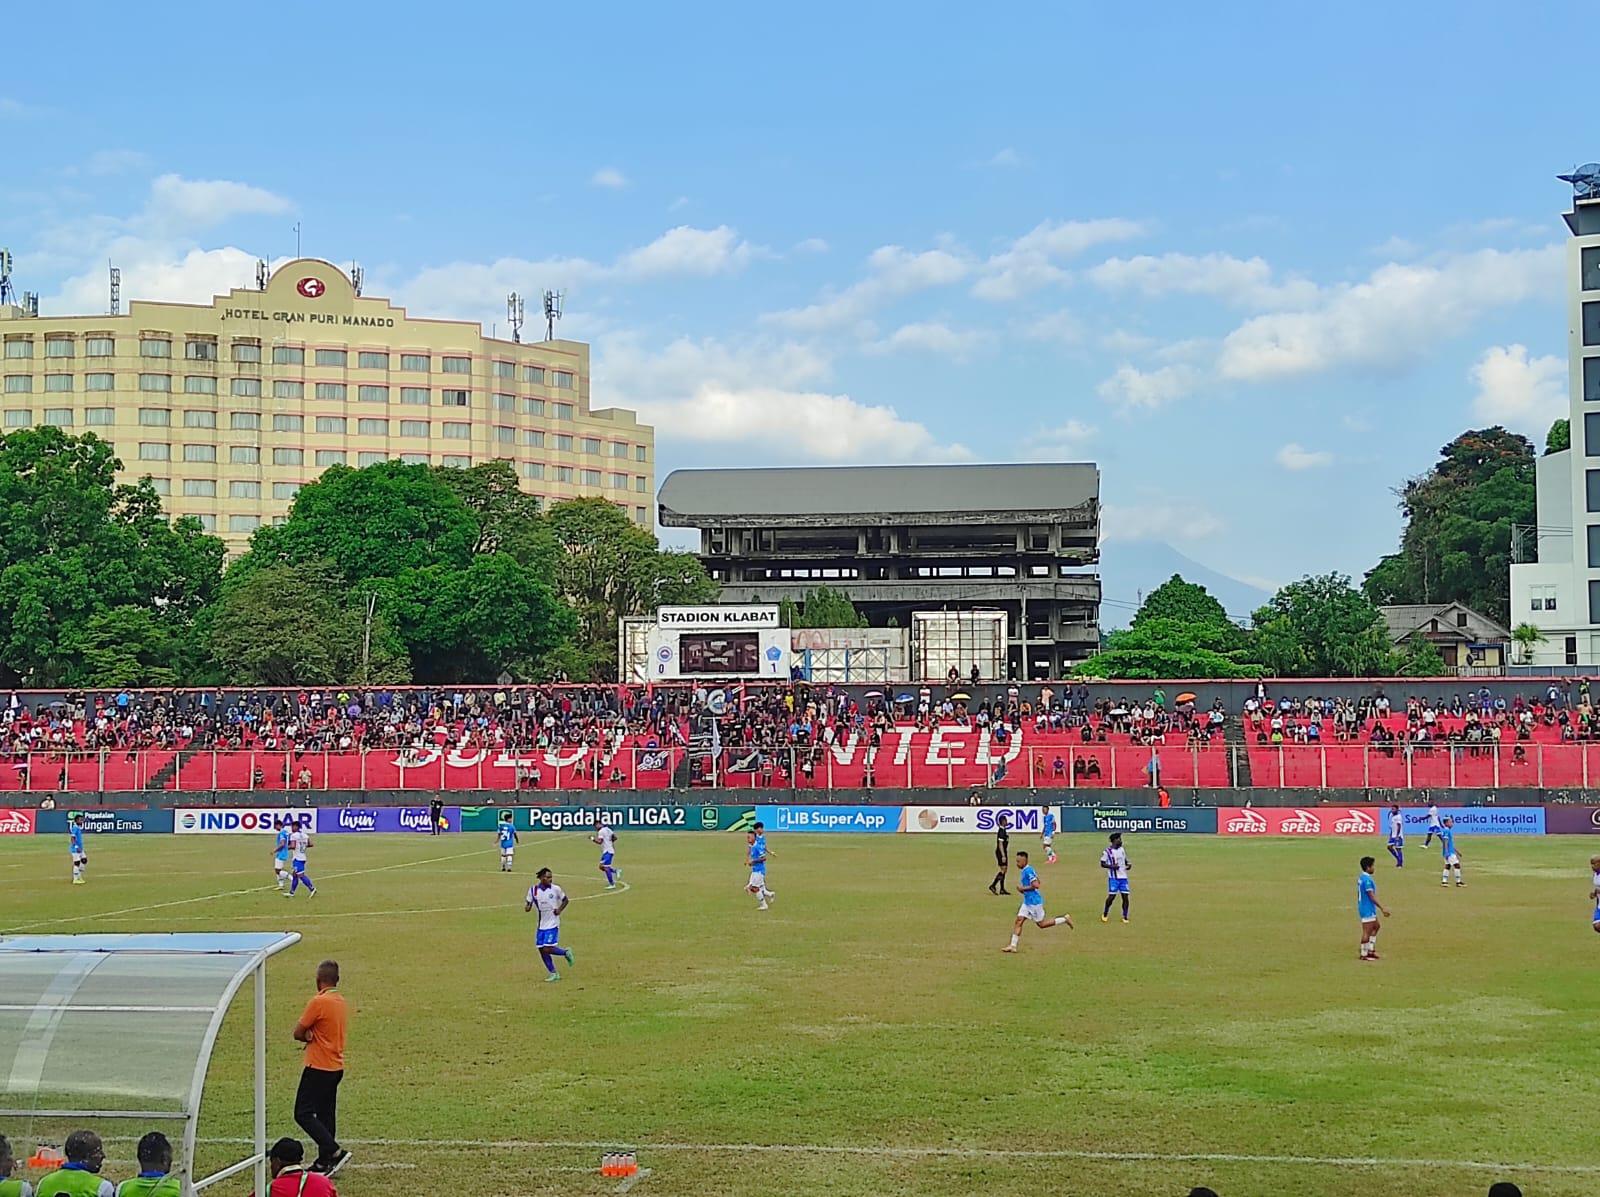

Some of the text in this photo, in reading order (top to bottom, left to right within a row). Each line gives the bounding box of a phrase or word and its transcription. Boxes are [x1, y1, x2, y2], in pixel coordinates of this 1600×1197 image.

[225, 308, 394, 328] HOTEL GRAN PURI MANADO
[661, 611, 776, 622] STADION KLABAT
[67, 819, 142, 832] Tungan Emas
[200, 812, 313, 830] INDOSIAR
[529, 808, 685, 830] Pegadaian LIGA 2
[787, 812, 885, 828] LIB Super App
[940, 815, 965, 824] Emtek
[976, 809, 1038, 830] SCM
[1095, 817, 1186, 831] Tabungan Emas
[1445, 813, 1487, 823] edika
[1491, 813, 1537, 825] Hospital
[1227, 821, 1267, 833] SPECS
[1280, 821, 1320, 833] SPECS
[1334, 821, 1374, 833] SPECS
